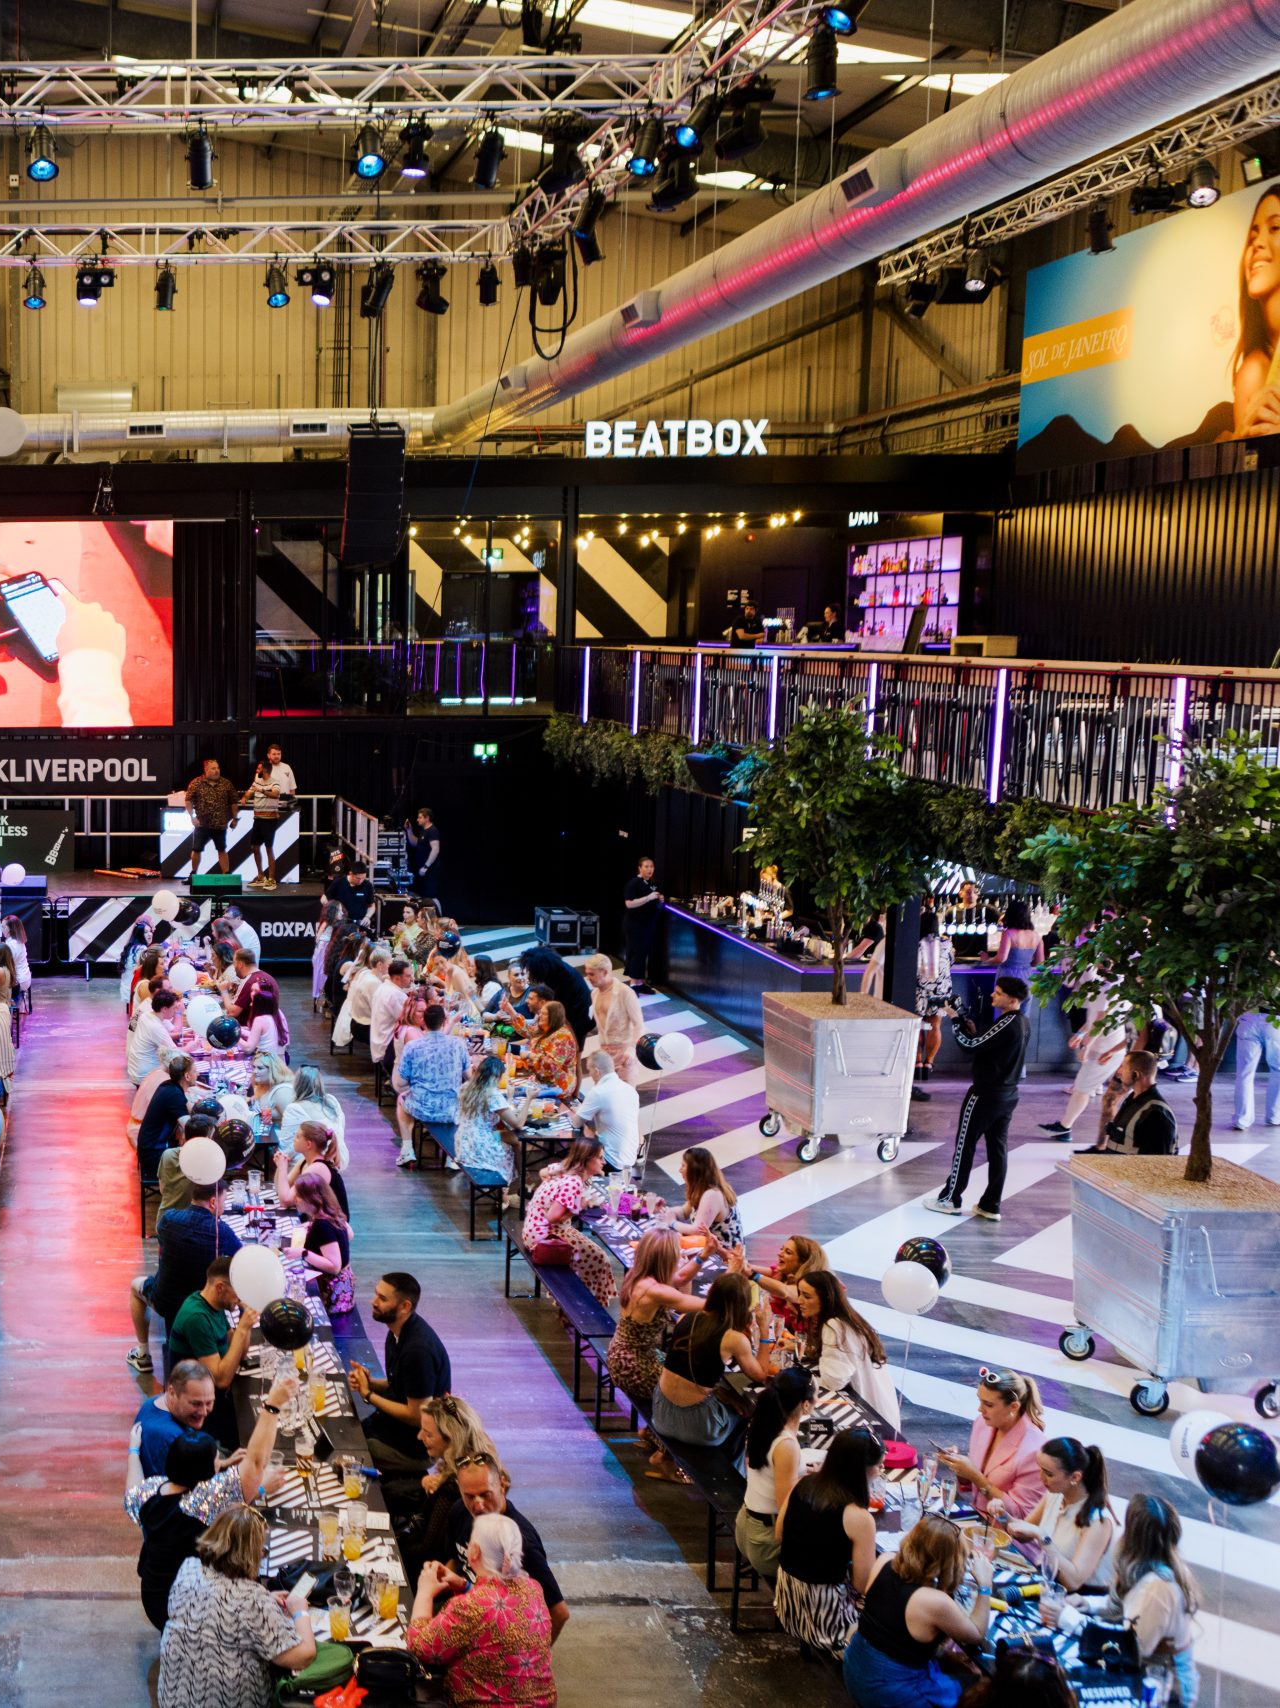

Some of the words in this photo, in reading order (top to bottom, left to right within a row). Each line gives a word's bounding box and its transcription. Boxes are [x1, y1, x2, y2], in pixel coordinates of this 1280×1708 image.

[1023, 347, 1049, 378] SOL
[1051, 342, 1066, 361] DE
[1064, 325, 1128, 369] JANEIRO
[585, 419, 769, 457] BEATBOX
[261, 921, 320, 937] BOXPA
[1080, 1686, 1132, 1699] RESERVED
